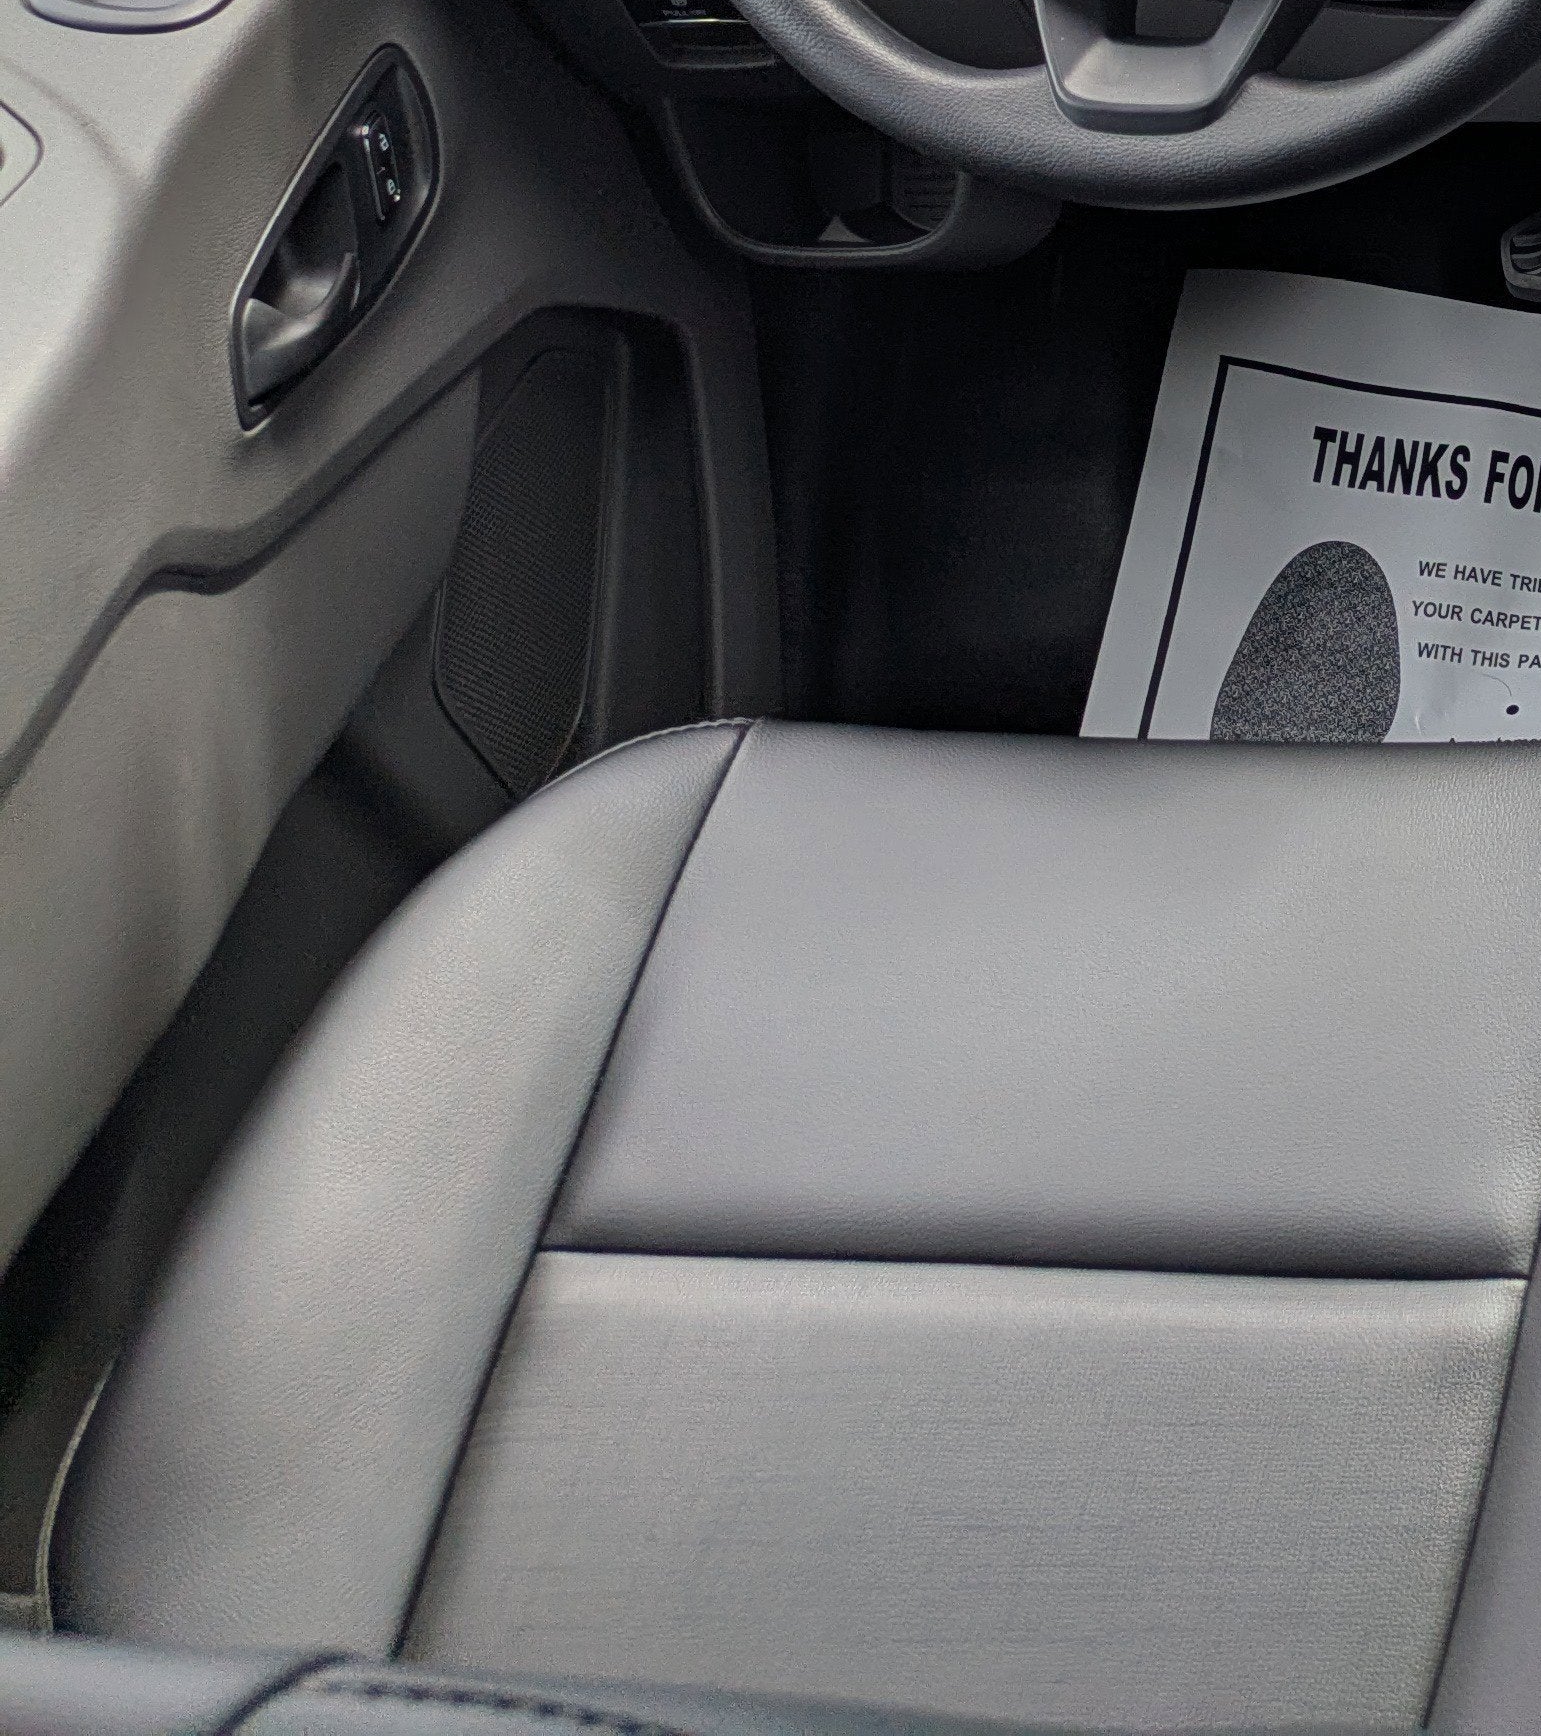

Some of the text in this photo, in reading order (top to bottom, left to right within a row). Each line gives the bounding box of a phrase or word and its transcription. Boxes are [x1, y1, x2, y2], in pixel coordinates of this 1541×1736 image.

[1312, 425, 1471, 501] THANKS
[1418, 560, 1448, 579] WE
[1453, 565, 1503, 589] HAVE
[1411, 600, 1464, 625] YOUR
[1417, 641, 1465, 665] WITH
[1470, 650, 1512, 669] THIS
